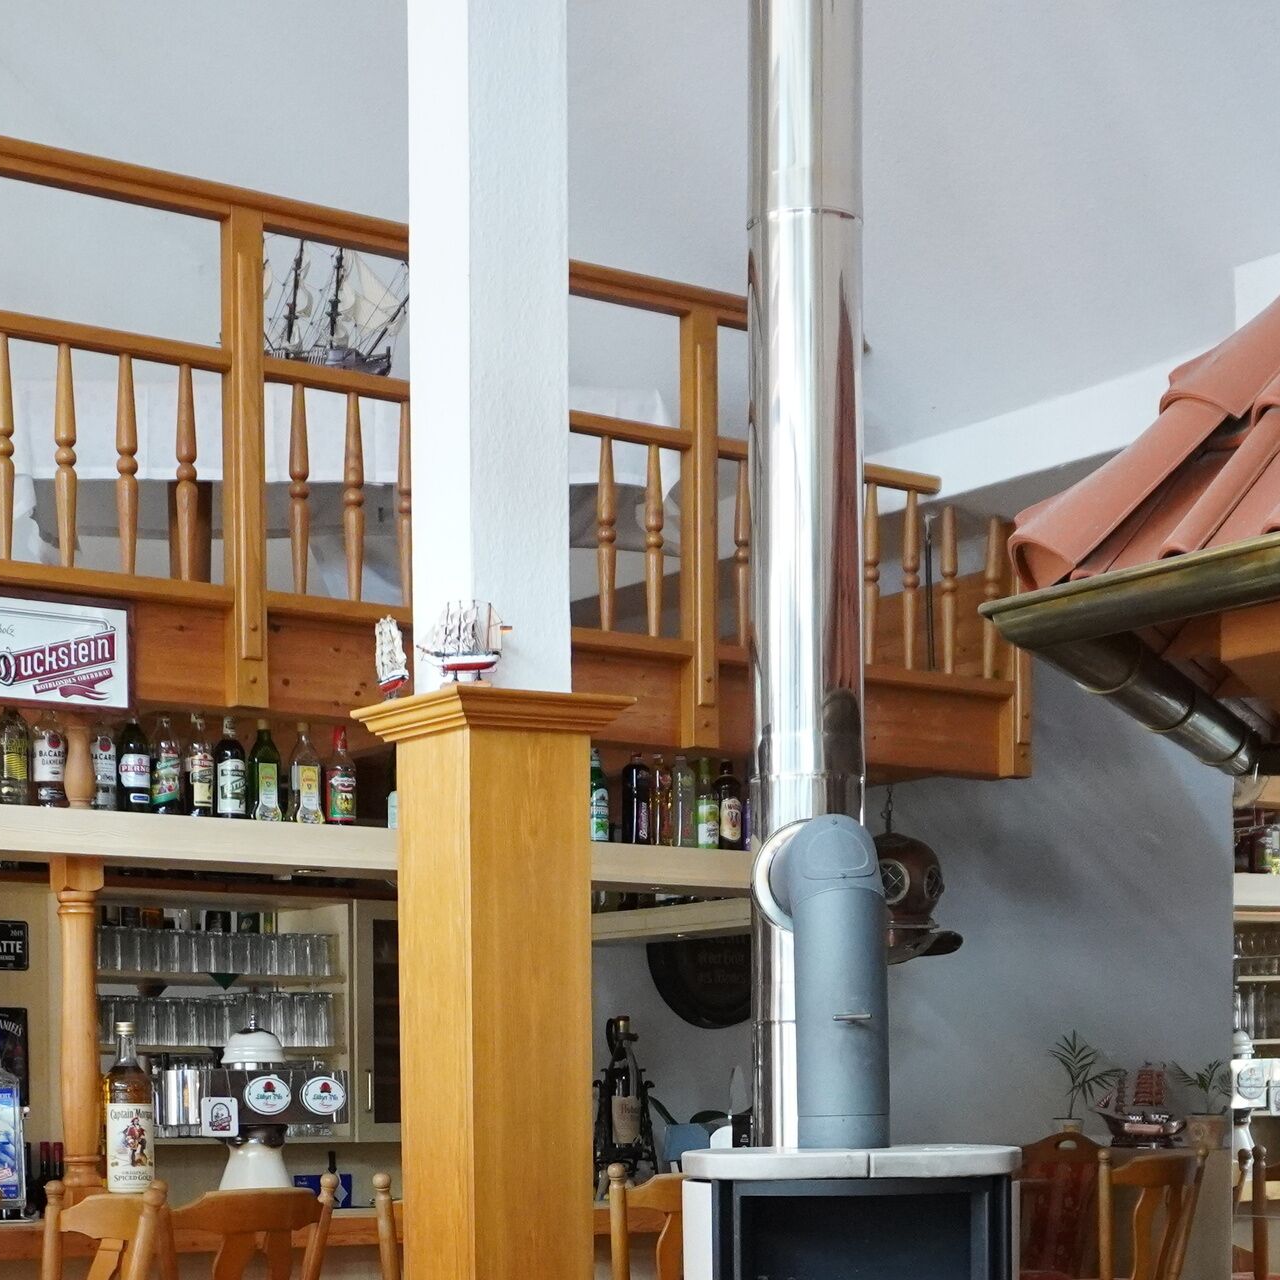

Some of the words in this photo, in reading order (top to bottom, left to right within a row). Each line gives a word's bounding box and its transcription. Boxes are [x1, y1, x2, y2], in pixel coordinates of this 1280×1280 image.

[38, 749, 65, 758] BACARD
[121, 763, 150, 772] PERNO
[110, 1109, 133, 1120] Captain
[135, 1108, 153, 1120] Morga
[114, 1174, 138, 1182] SPICED
